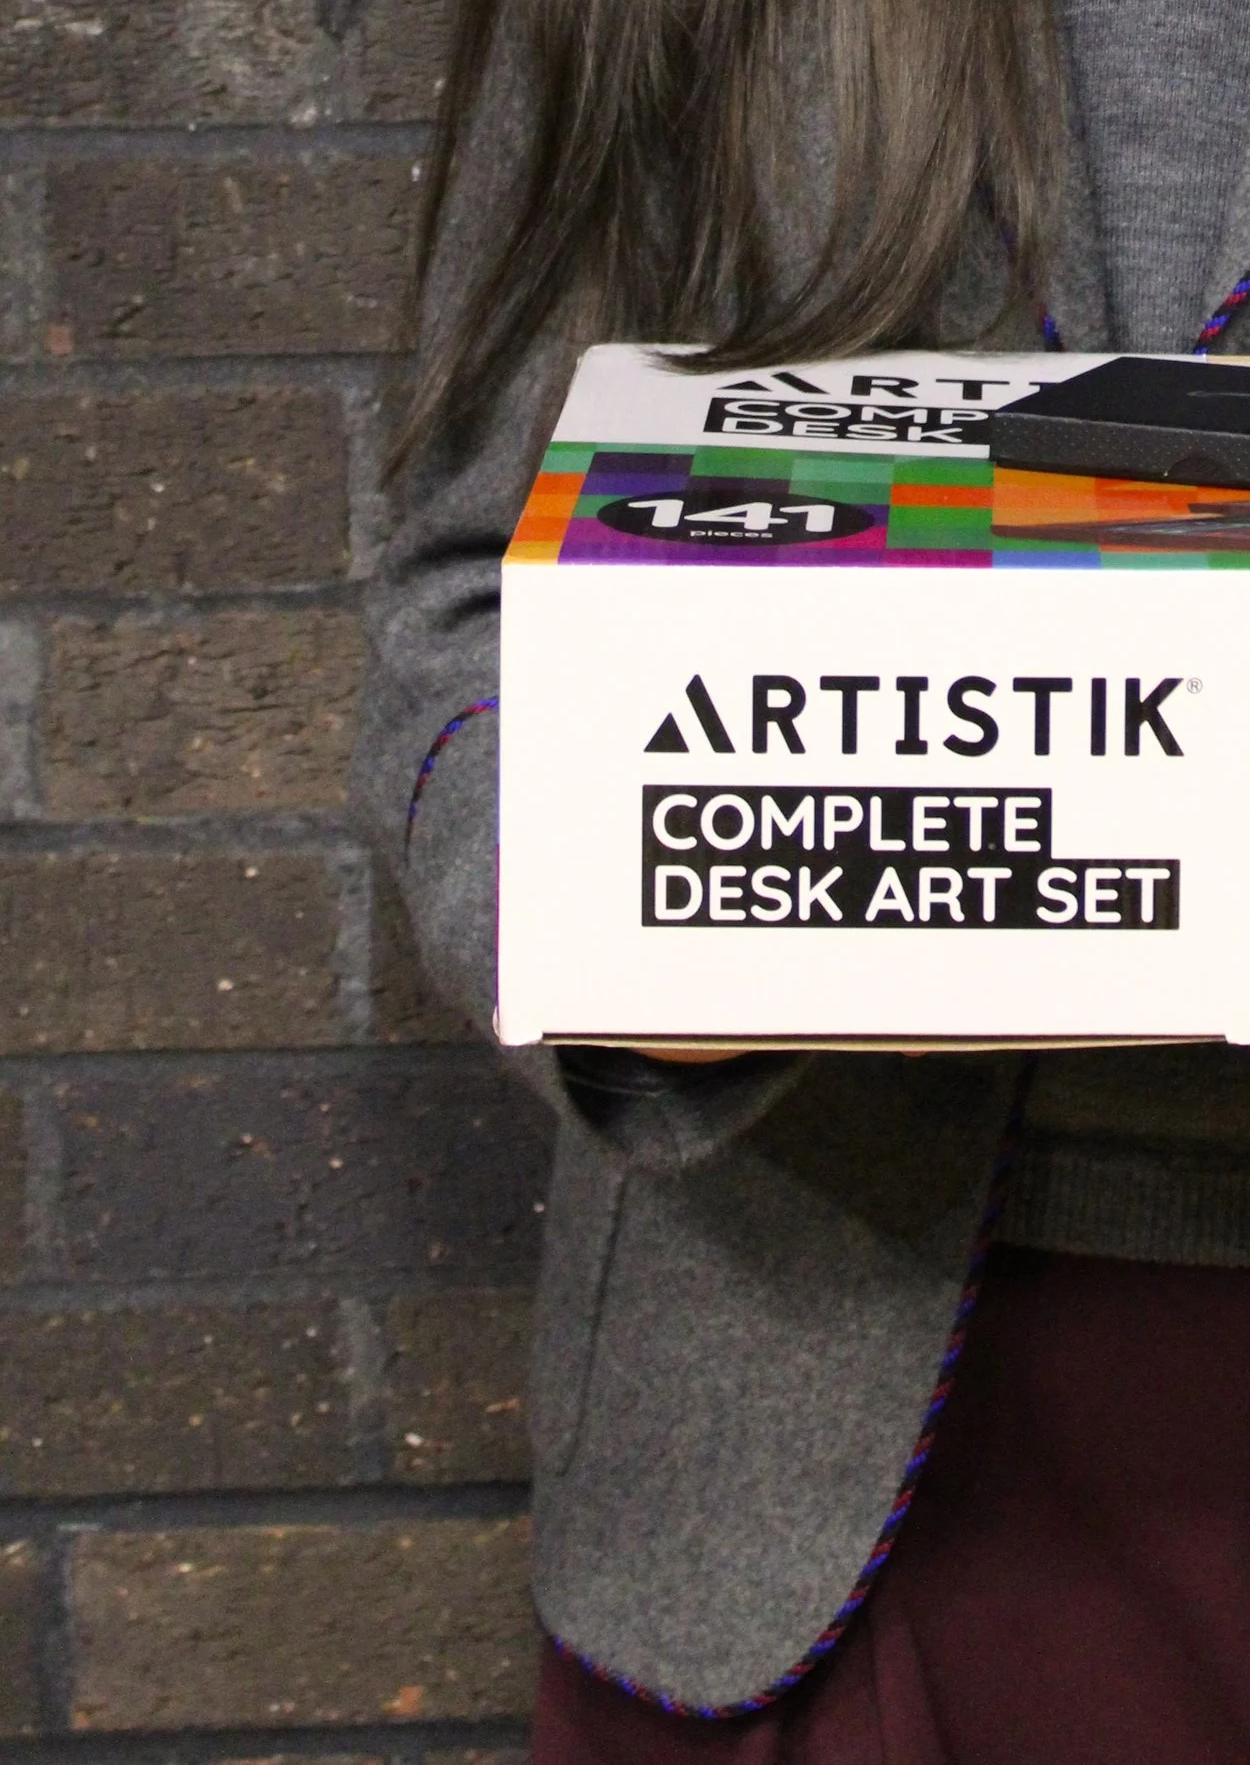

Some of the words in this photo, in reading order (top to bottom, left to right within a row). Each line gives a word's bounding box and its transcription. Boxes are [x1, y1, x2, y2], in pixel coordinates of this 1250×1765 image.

[715, 371, 1046, 400] ART
[723, 399, 990, 426] COMP
[721, 416, 964, 443] DESK
[627, 499, 835, 533] 141
[652, 794, 1041, 852] COMPLETE
[654, 865, 843, 921] DESK
[865, 867, 1012, 922] ART
[1036, 868, 1170, 923] SET
